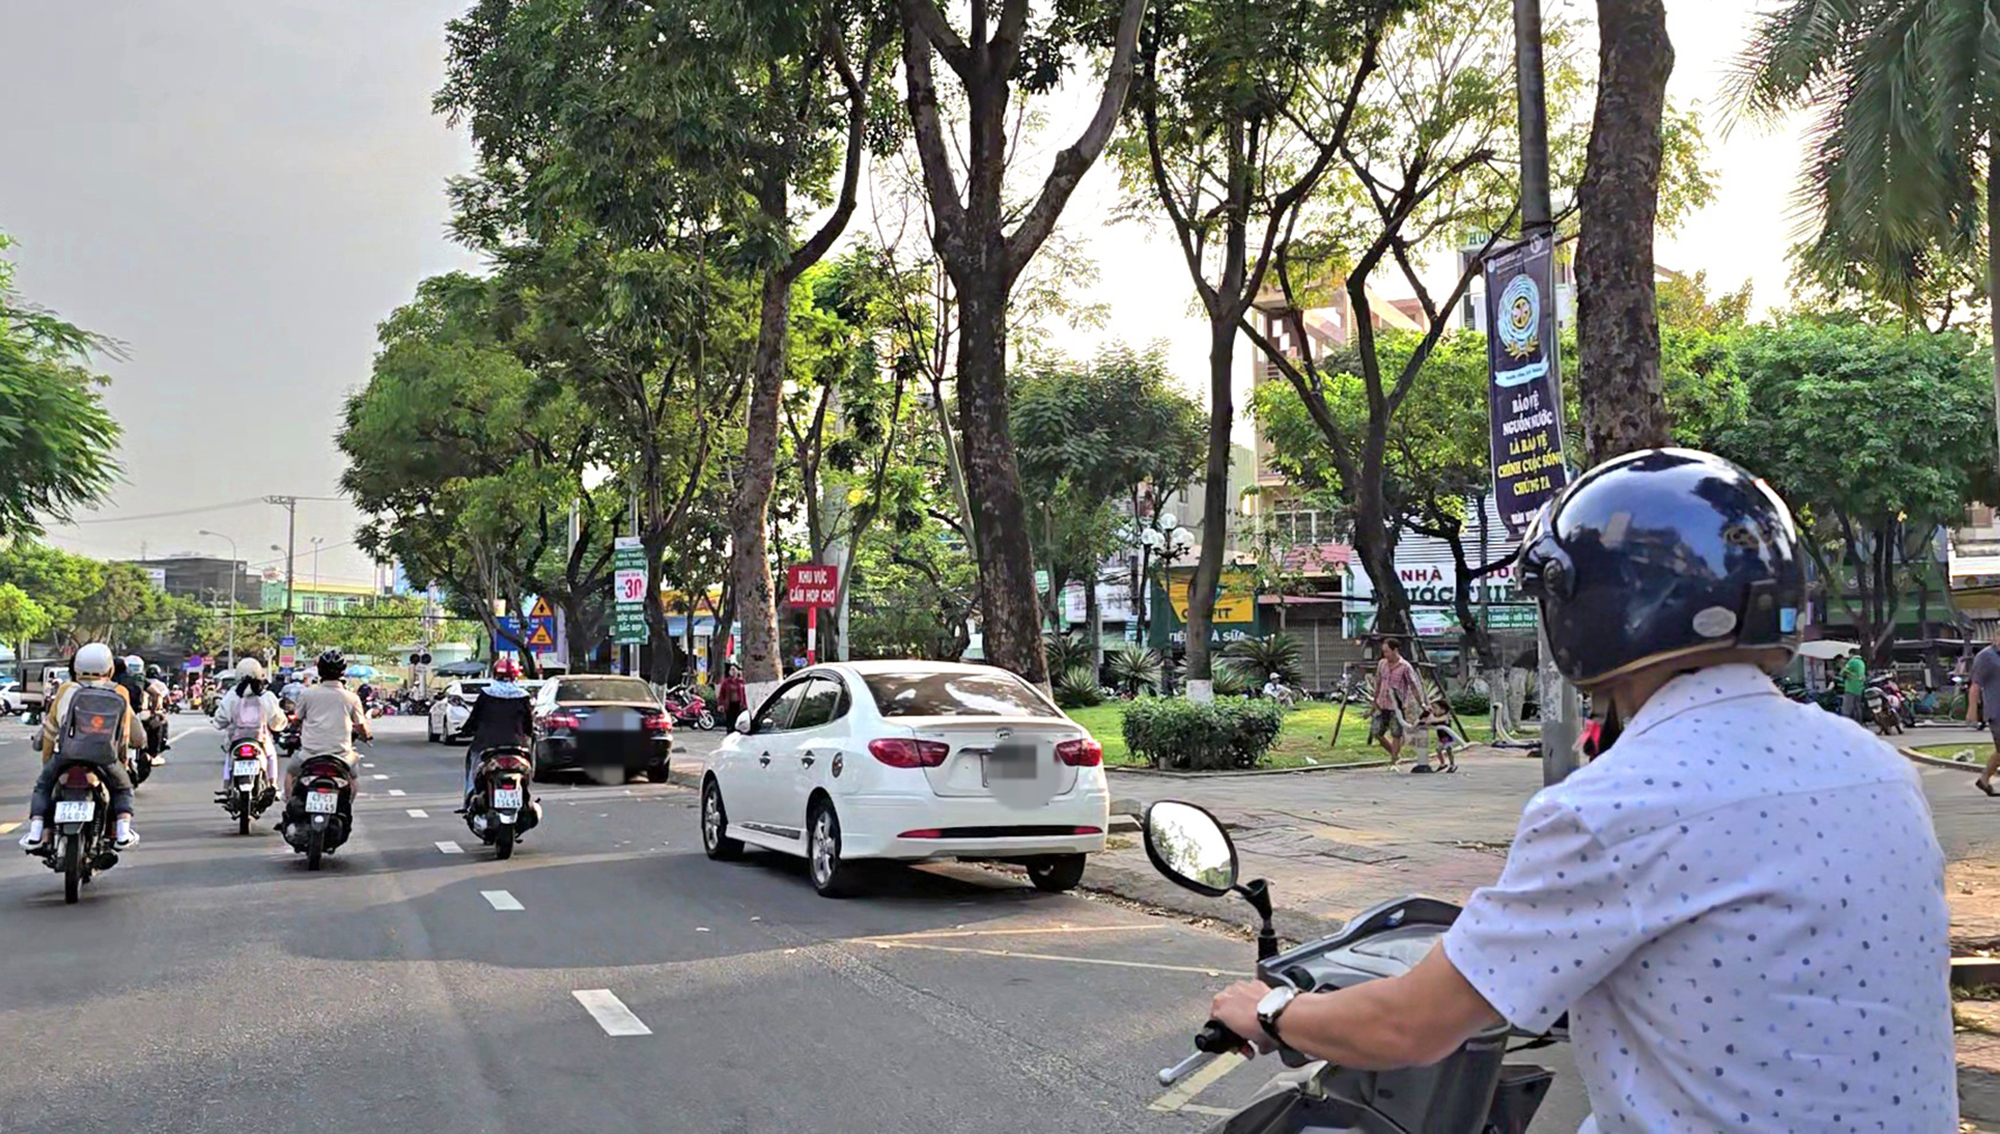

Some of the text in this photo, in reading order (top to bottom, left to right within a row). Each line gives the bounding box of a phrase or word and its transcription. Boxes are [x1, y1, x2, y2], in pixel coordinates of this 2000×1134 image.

[798, 568, 828, 585] KHU VỰC
[1401, 565, 1443, 582] NHÀ
[790, 584, 805, 602] CẤM
